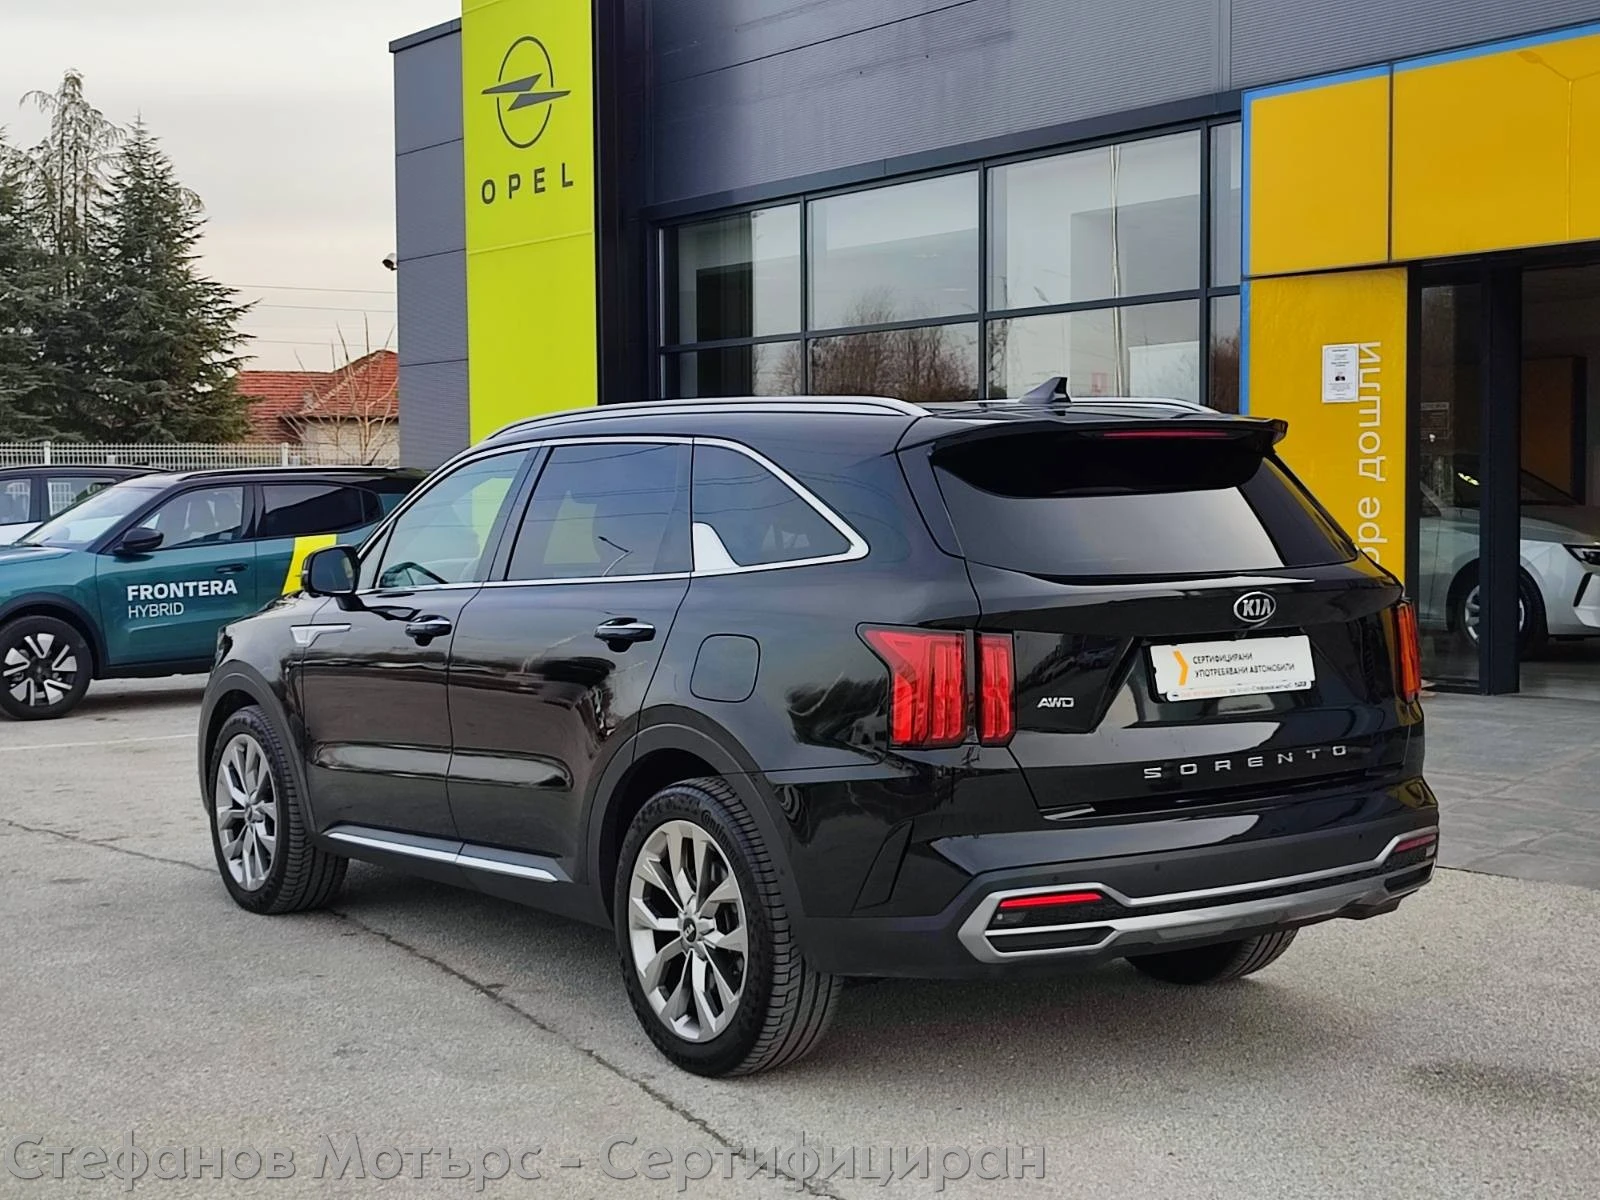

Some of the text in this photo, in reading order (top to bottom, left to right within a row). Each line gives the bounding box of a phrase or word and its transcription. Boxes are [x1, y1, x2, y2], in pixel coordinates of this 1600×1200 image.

[481, 162, 574, 205] OPEL
[1358, 341, 1386, 482] дошли
[127, 579, 238, 601] FRONTERA
[128, 602, 184, 619] HYBRID
[1242, 598, 1271, 617] KIA
[1193, 653, 1253, 665] СЕРТИФИЦИРАНИ
[1195, 663, 1295, 679] УПОТРЕБЯВАНИ АВТОМОБИЛИ
[1037, 697, 1075, 709] AWD
[1143, 745, 1348, 779] SORENTO
